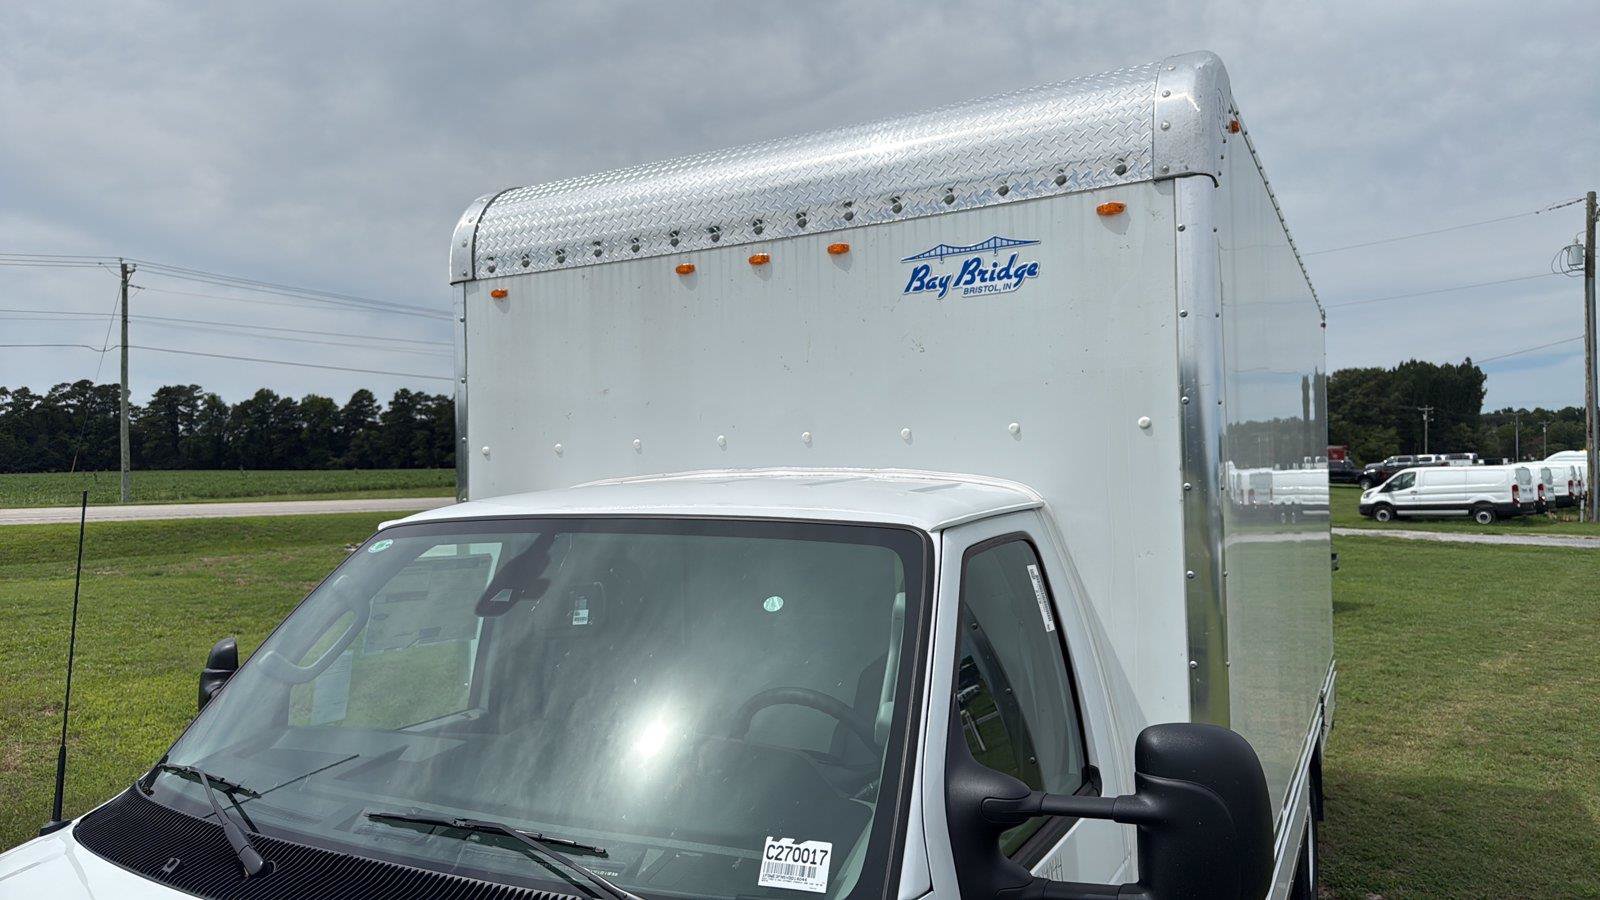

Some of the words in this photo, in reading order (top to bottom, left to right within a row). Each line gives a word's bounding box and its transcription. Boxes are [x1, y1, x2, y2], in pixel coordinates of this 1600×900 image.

[905, 264, 951, 298] Bay
[953, 253, 1038, 287] Bridge
[963, 285, 1001, 295] BRISTOL,
[1003, 283, 1012, 291] IN
[766, 844, 828, 865] C270017
